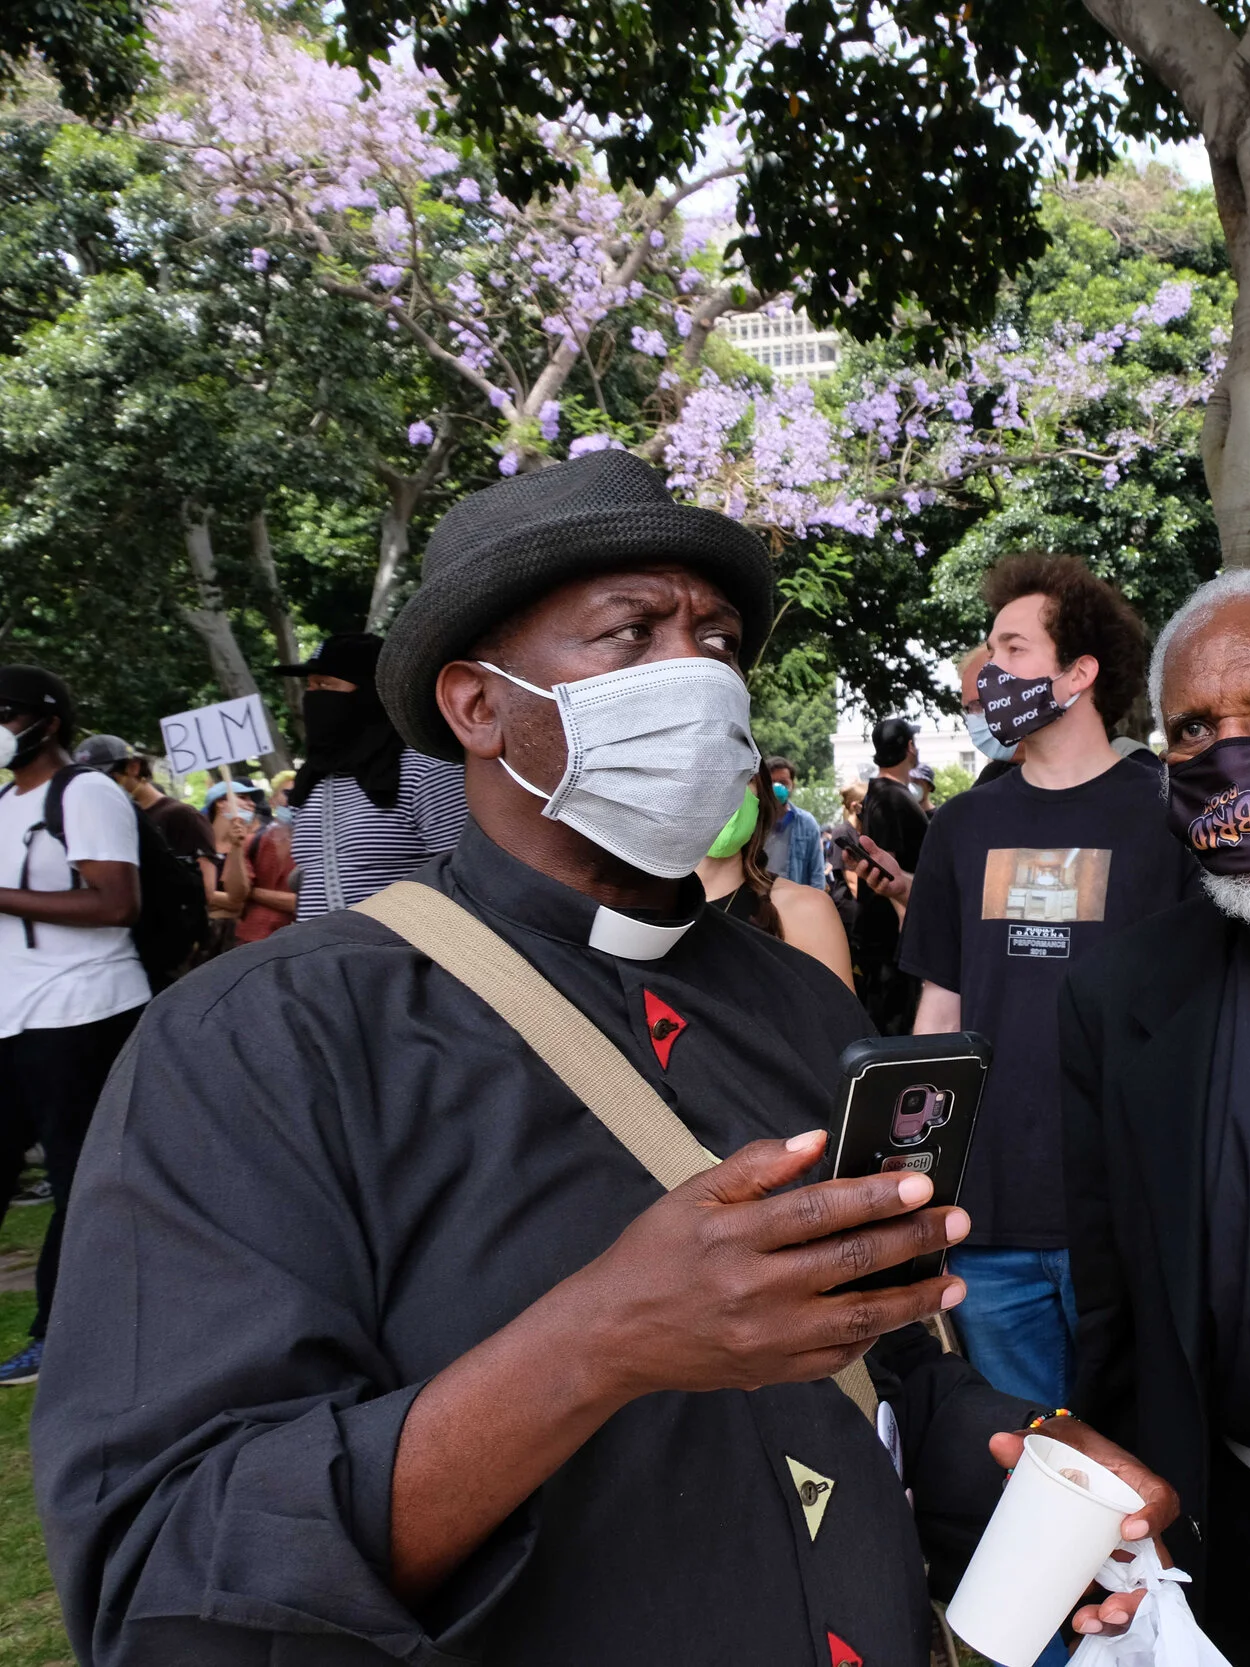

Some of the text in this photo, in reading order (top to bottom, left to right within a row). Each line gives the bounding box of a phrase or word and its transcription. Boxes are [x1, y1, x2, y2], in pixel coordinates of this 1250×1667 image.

[998, 673, 1016, 685] pyo
[1021, 682, 1048, 701] pyor
[988, 696, 1011, 711] pyor
[1012, 708, 1039, 727] pyor
[1016, 930, 1064, 938] DAYTONA
[1012, 939, 1066, 948] PERFORMANCE
